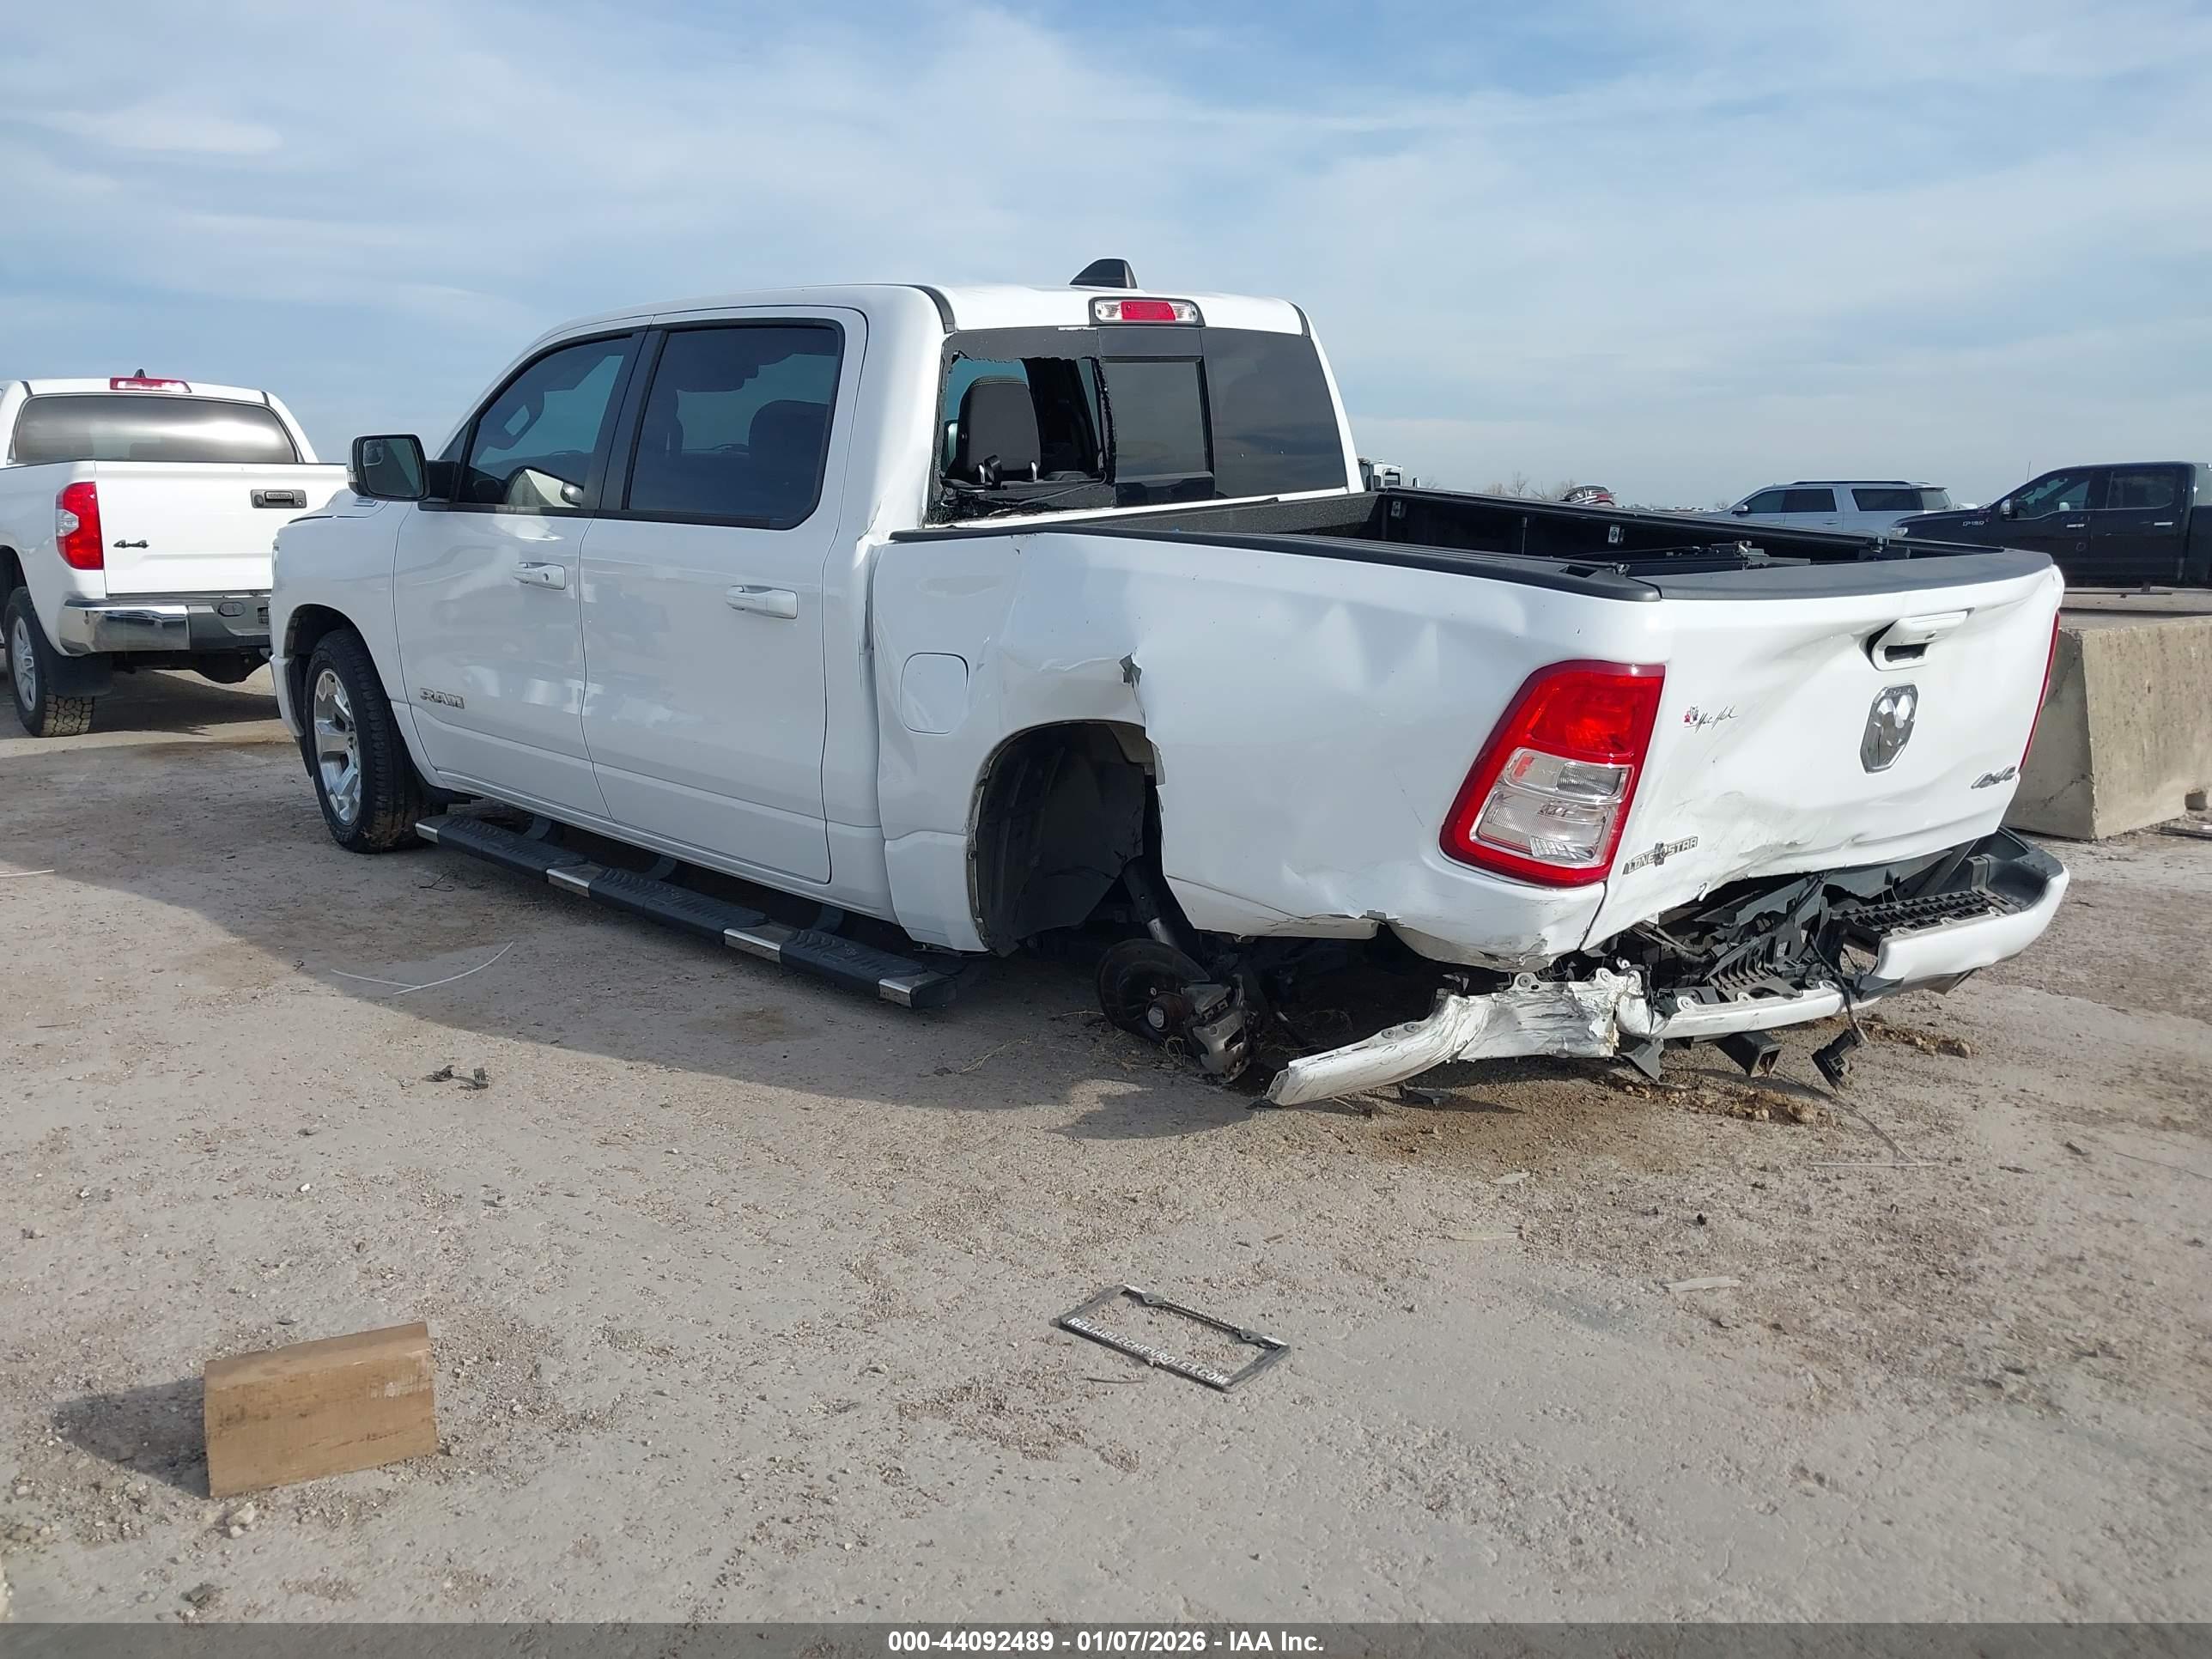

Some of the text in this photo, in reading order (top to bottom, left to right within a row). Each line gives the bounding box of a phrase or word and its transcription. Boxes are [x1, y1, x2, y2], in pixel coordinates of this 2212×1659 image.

[419, 687, 465, 709] RAM
[1627, 837, 1698, 873] LONE STAR
